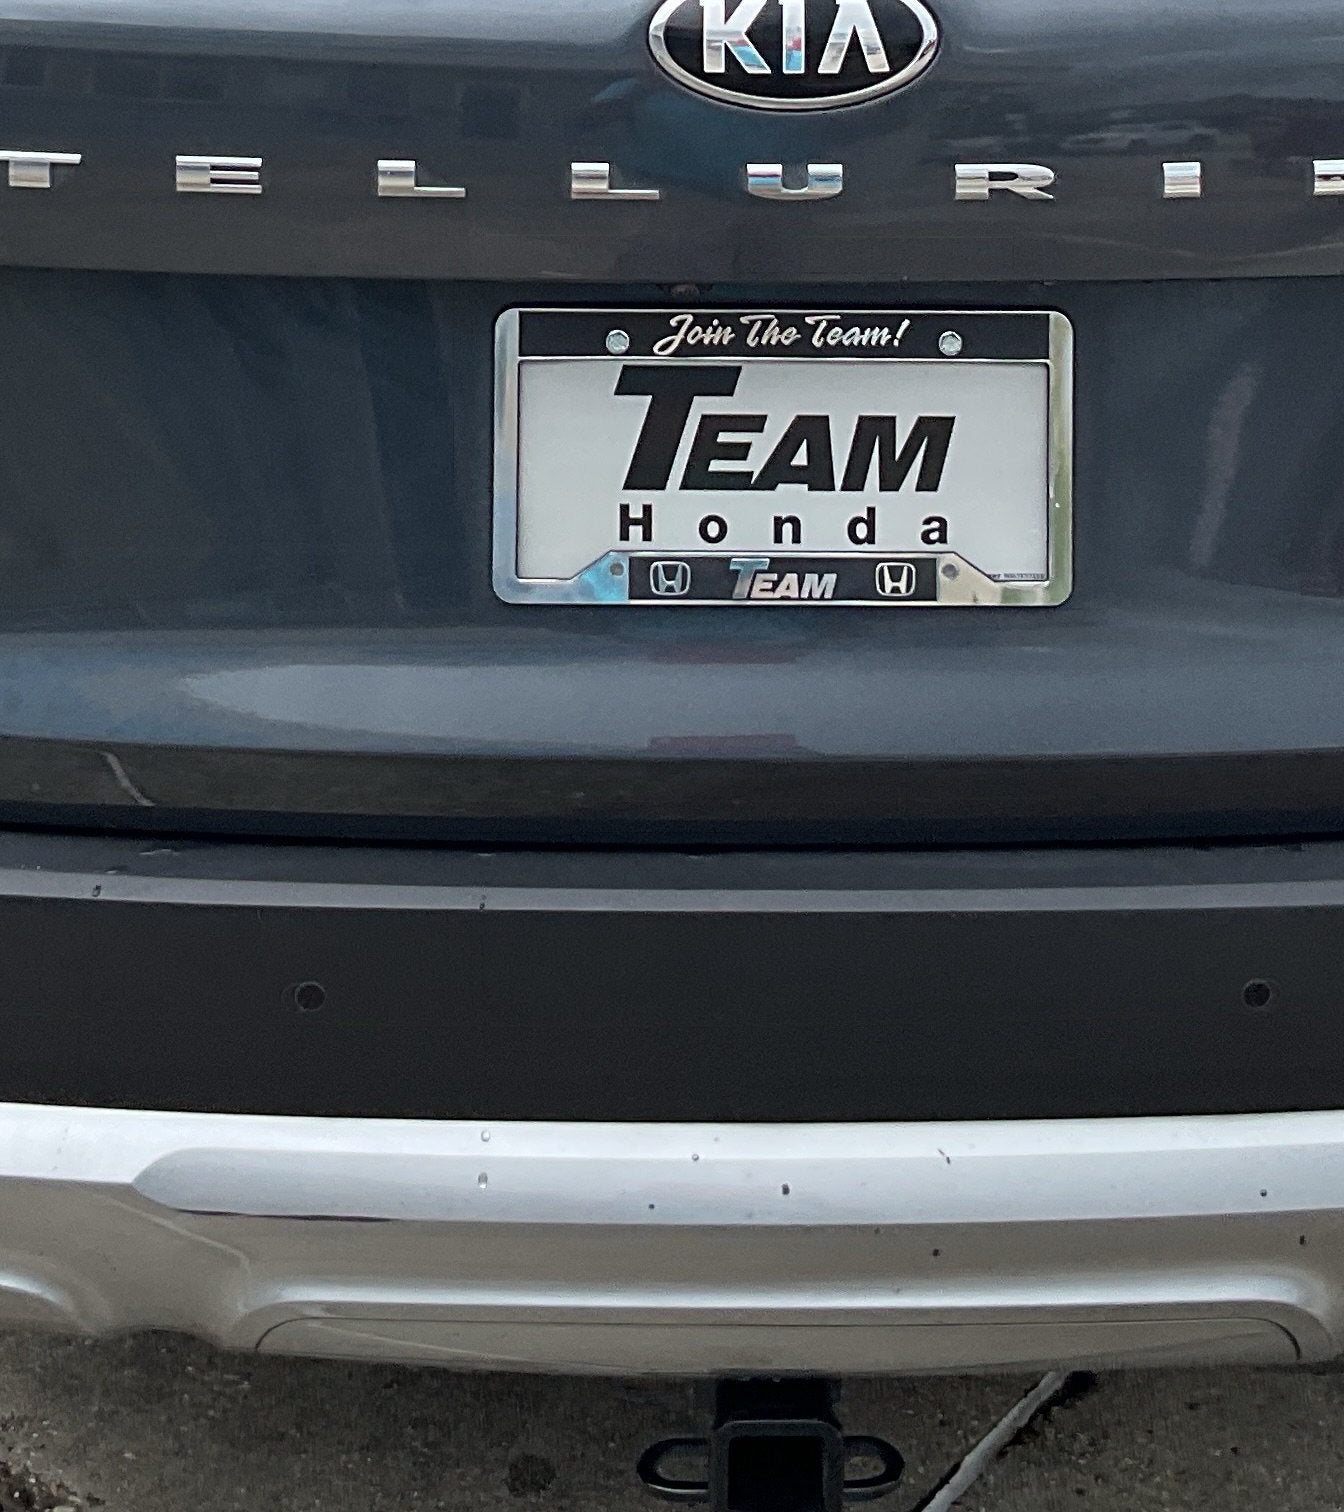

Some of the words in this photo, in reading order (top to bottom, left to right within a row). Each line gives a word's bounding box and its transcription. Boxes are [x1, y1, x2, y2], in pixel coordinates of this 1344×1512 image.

[653, 313, 735, 356] Join
[740, 314, 802, 347] The
[804, 315, 910, 348] Team!
[614, 364, 956, 492] TEAM
[619, 504, 949, 545] Honda
[729, 557, 838, 599] TEAM
